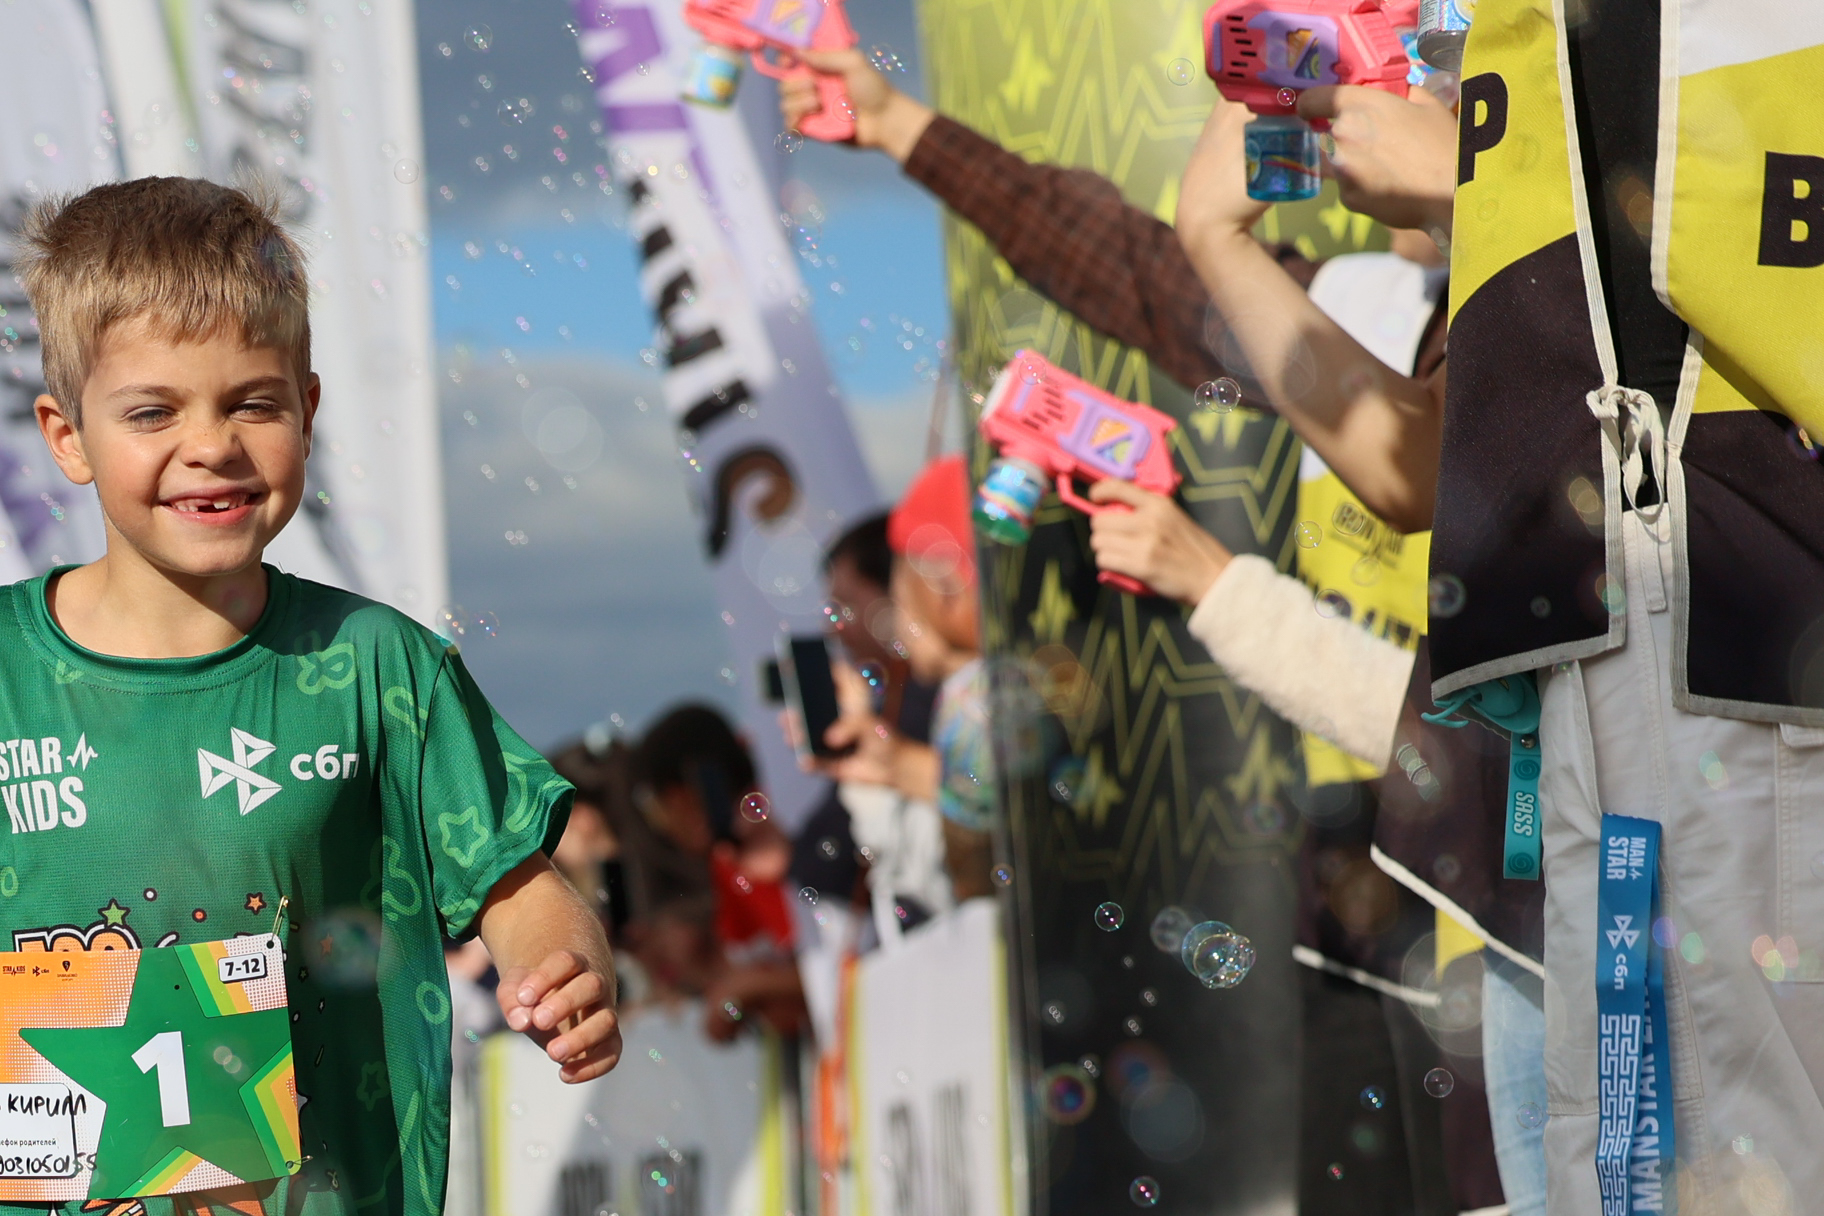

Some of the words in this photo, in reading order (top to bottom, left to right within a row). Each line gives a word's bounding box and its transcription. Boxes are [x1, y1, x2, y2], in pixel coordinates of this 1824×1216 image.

[1, 777, 87, 834] KIDS
[1513, 791, 1535, 837] SASS
[1607, 836, 1629, 881] STAR
[1629, 837, 1647, 868] MAN
[225, 958, 260, 977] 7-12
[1614, 953, 1628, 990] сбп
[131, 1031, 191, 1127] 1
[19, 1138, 57, 1147] родителей
